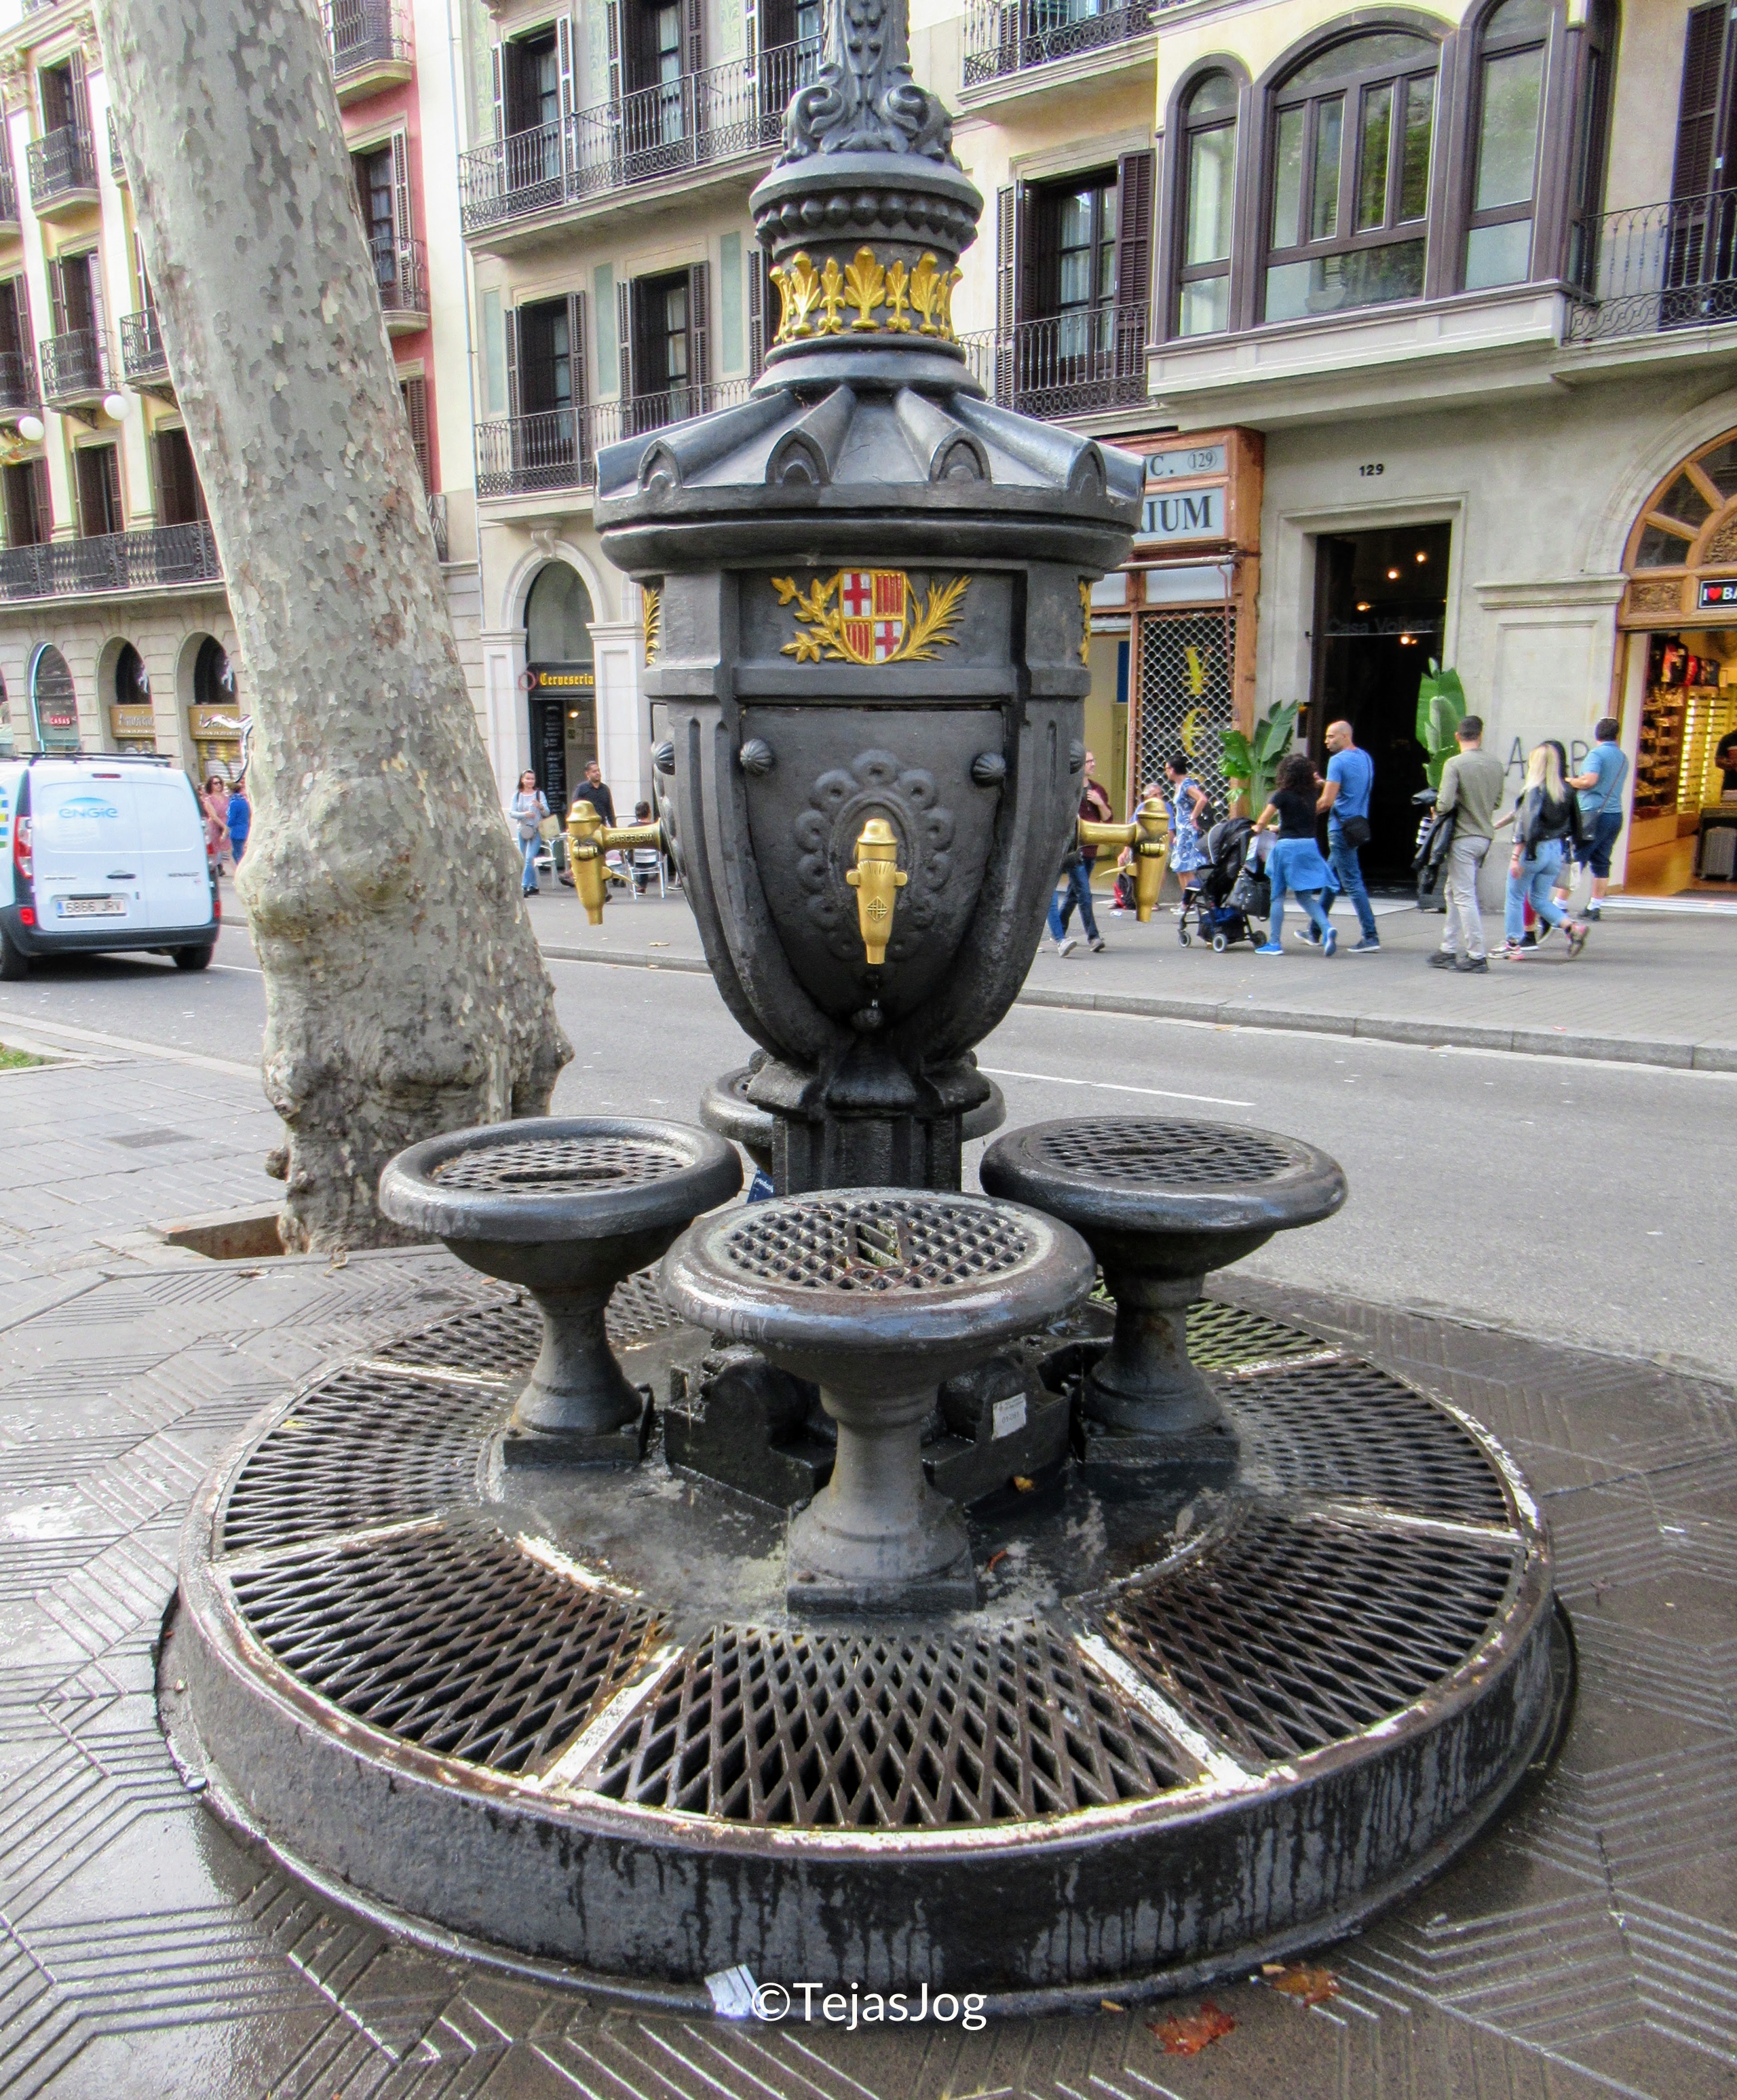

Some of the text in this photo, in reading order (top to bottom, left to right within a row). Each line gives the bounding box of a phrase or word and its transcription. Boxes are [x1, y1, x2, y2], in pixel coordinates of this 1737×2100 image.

[1191, 451, 1213, 469] 129
[1359, 463, 1384, 476] 129
[539, 672, 594, 686] Cerveseria
[611, 833, 654, 843] BARCELONA
